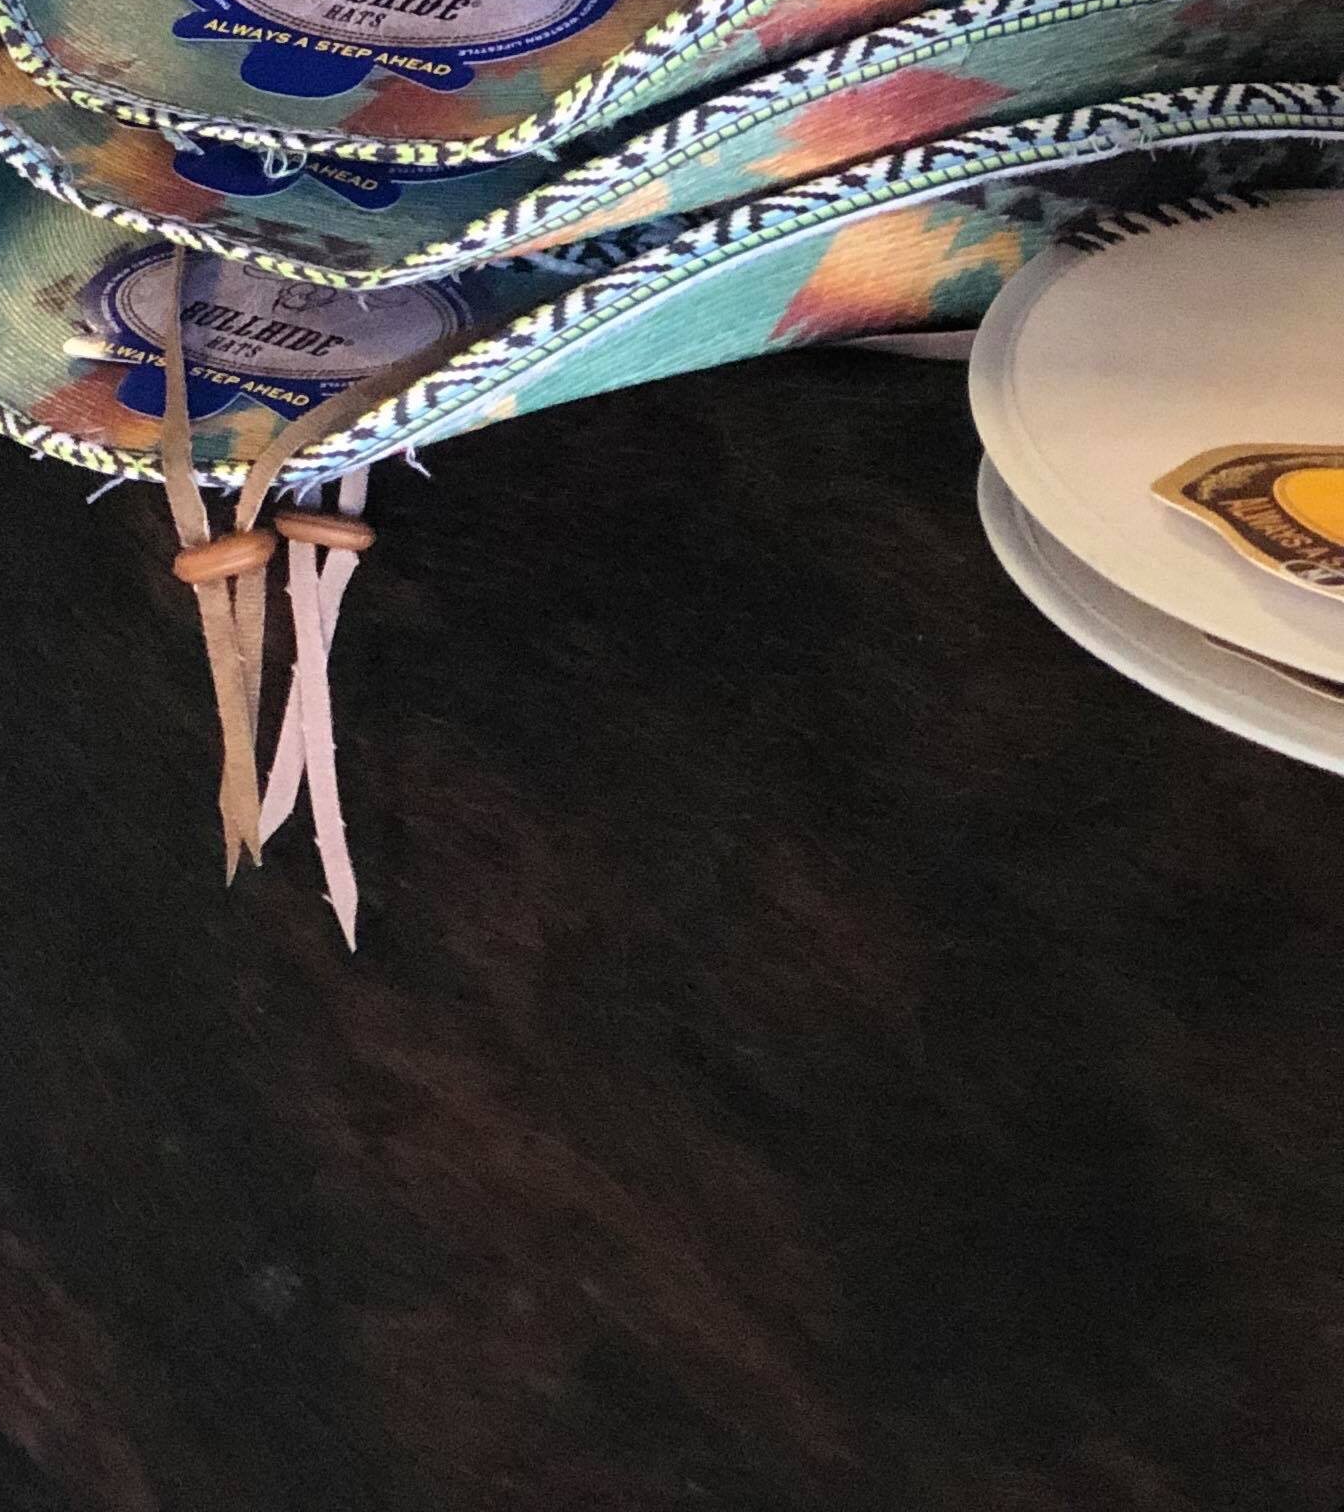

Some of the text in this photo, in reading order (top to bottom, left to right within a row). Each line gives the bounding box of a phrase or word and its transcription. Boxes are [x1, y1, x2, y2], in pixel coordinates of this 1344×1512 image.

[323, 3, 388, 28] HATS
[525, 16, 580, 45] WESTERN
[204, 18, 453, 76] ALWAYS A STEP AHEAD
[457, 40, 524, 58] LIFESTYLE
[306, 161, 379, 191] AHEAD
[203, 335, 264, 360] HATS
[100, 341, 311, 408] LWAYS STEP AHEAD
